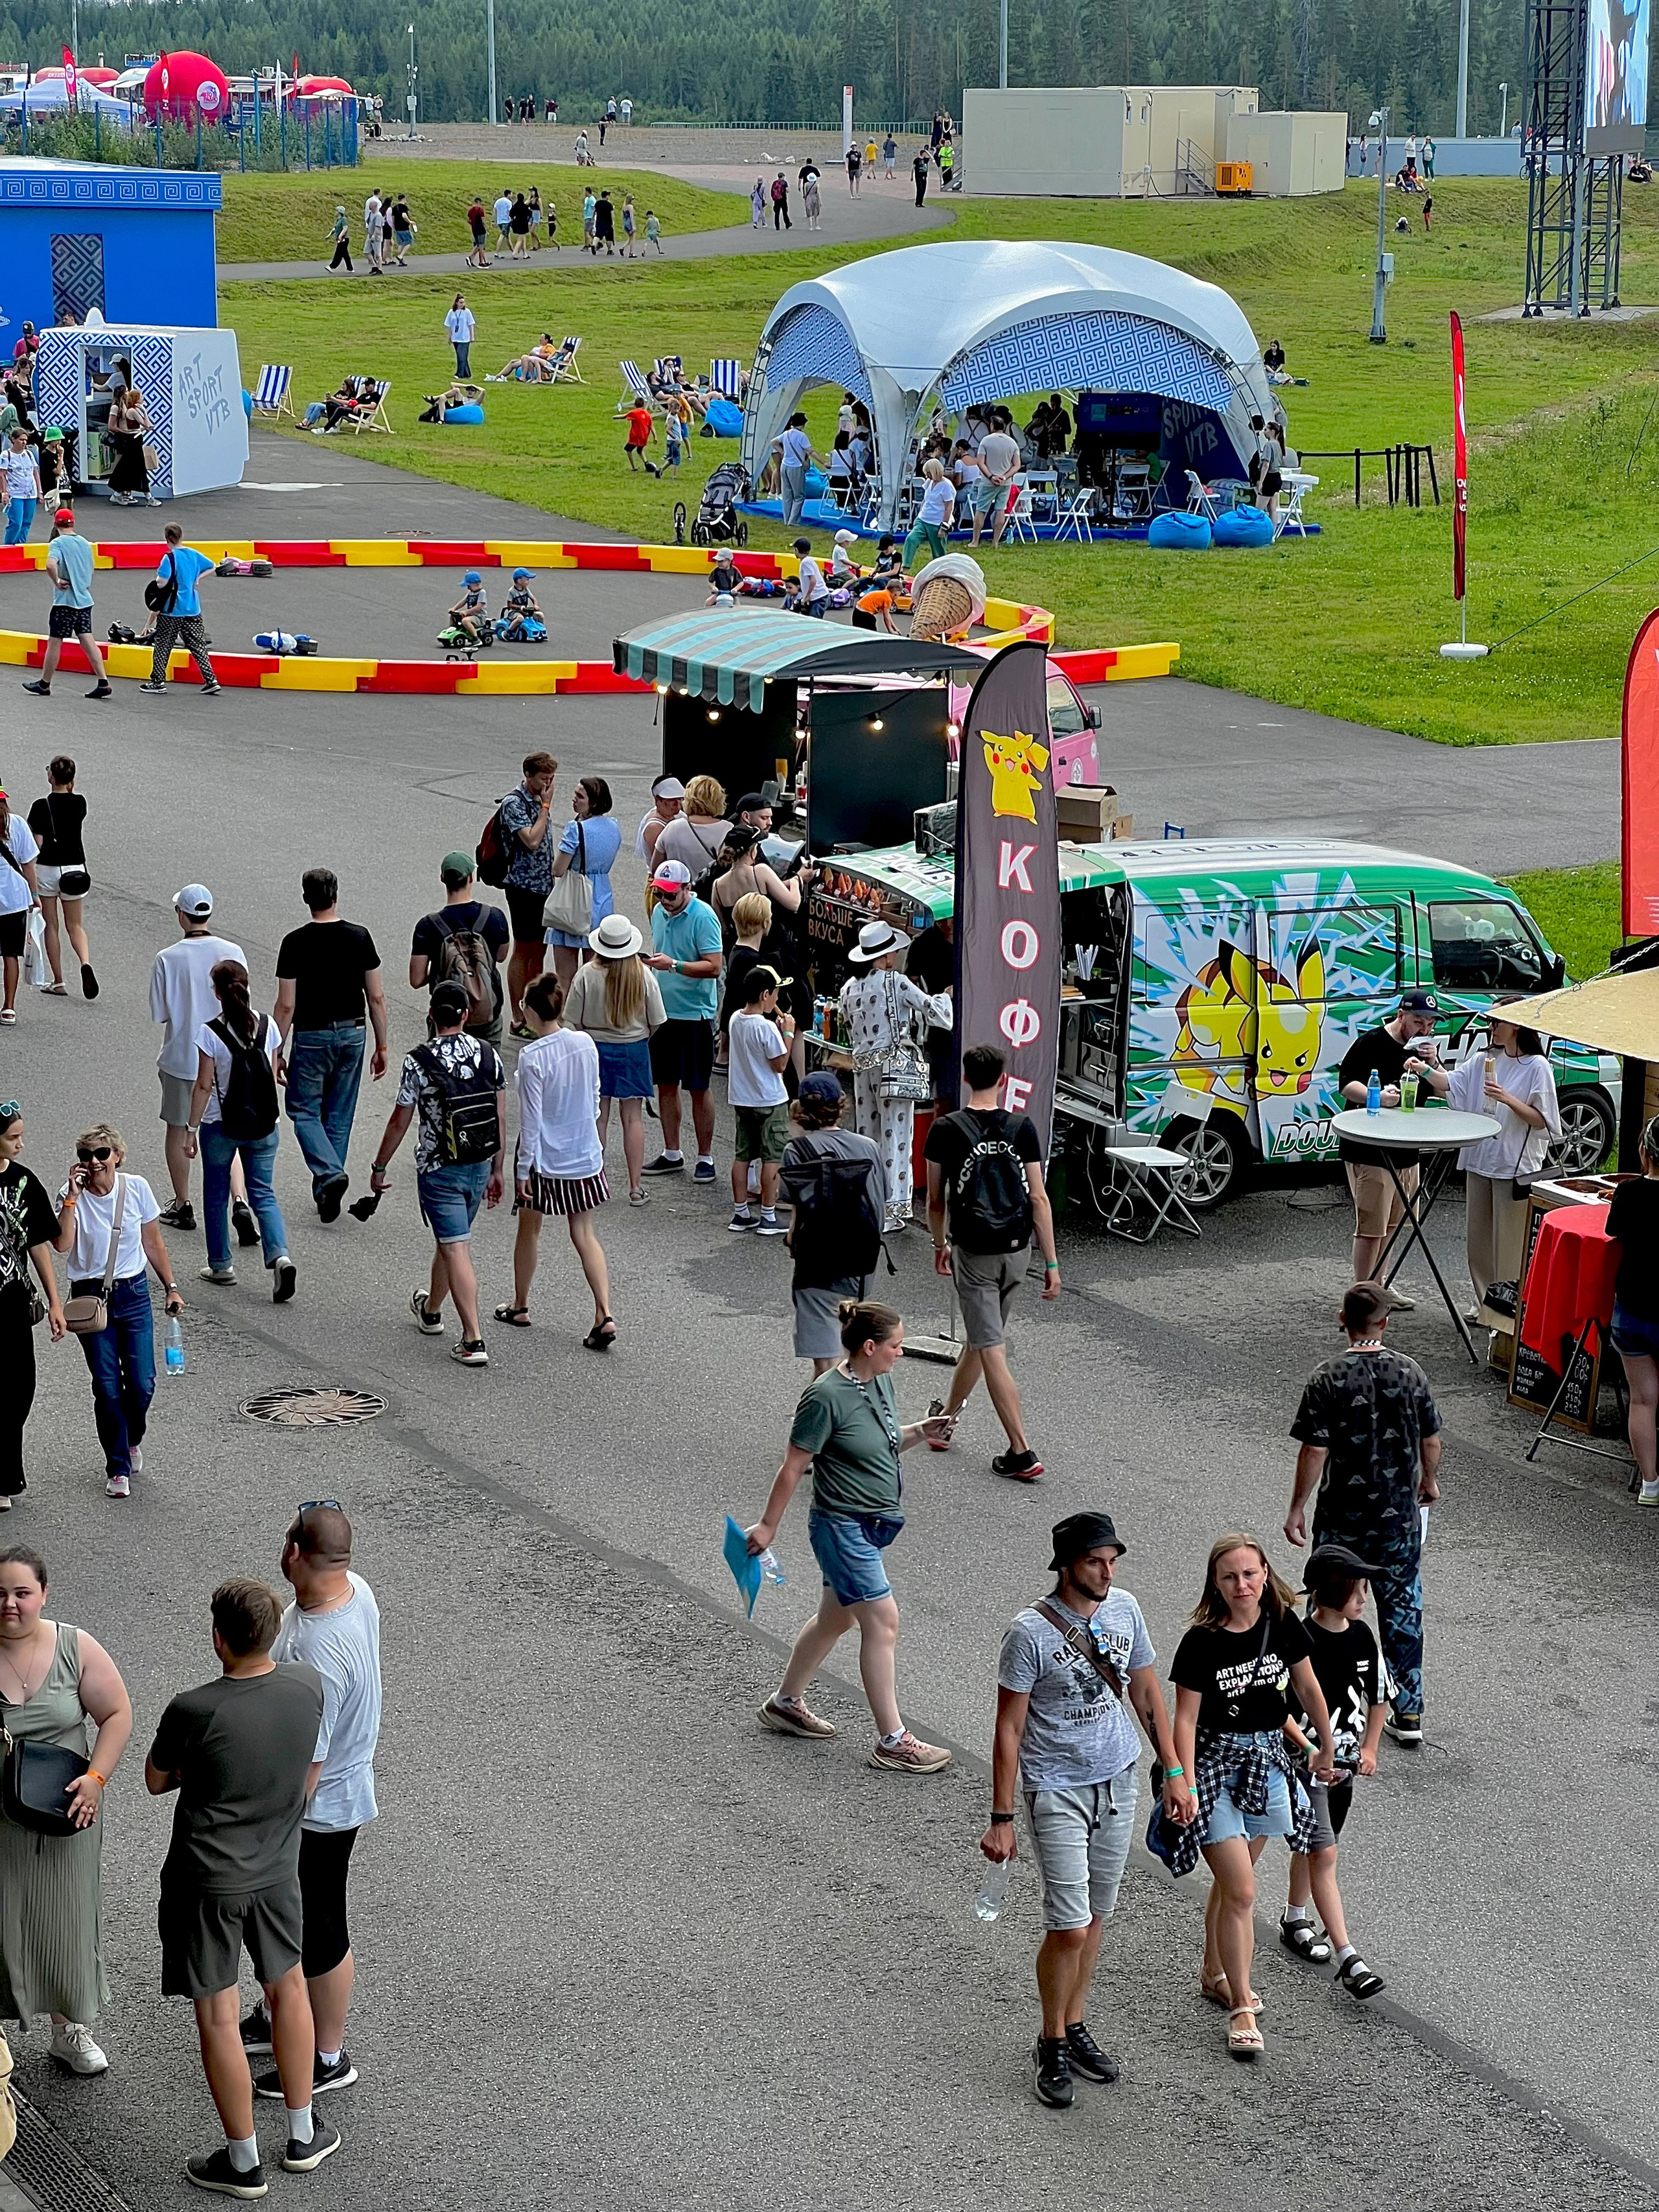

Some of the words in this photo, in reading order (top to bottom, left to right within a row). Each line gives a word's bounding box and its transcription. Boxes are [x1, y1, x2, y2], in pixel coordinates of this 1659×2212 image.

[179, 352, 202, 401] ART
[188, 364, 222, 419] SPORT
[205, 398, 230, 436] VTB
[1163, 402, 1207, 439] SPO
[1185, 422, 1218, 462] VTB
[809, 898, 853, 928] БОЛЬШЕ
[808, 919, 844, 946] ВКУСА
[1273, 1120, 1340, 1156] DOU
[1216, 1666, 1235, 1681] ART
[1262, 1653, 1277, 1665] NO
[1227, 1689, 1239, 1698] art
